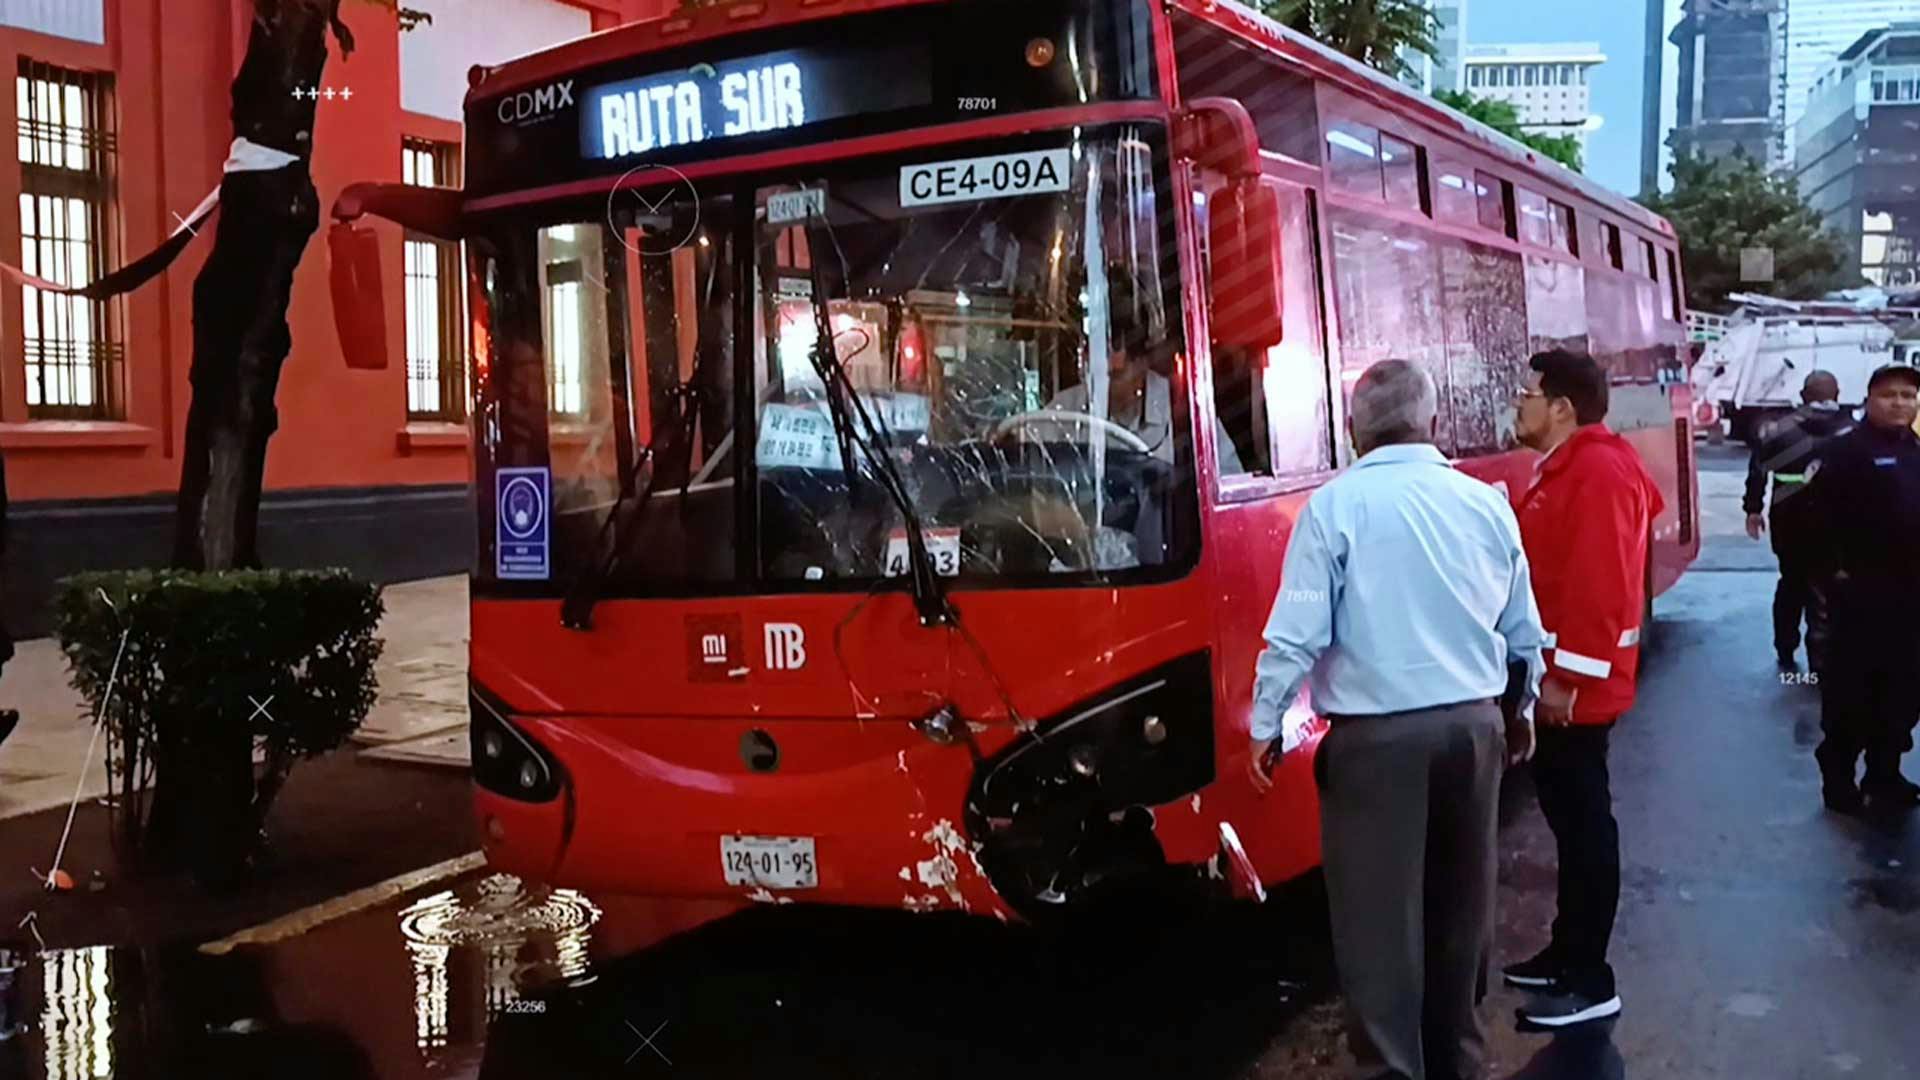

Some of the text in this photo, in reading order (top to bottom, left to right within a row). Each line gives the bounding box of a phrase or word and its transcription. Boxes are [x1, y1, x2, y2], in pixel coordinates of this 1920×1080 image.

[498, 80, 574, 123] CDMX
[601, 62, 804, 159] RUTA SUR
[910, 156, 1059, 200] CE4-09A
